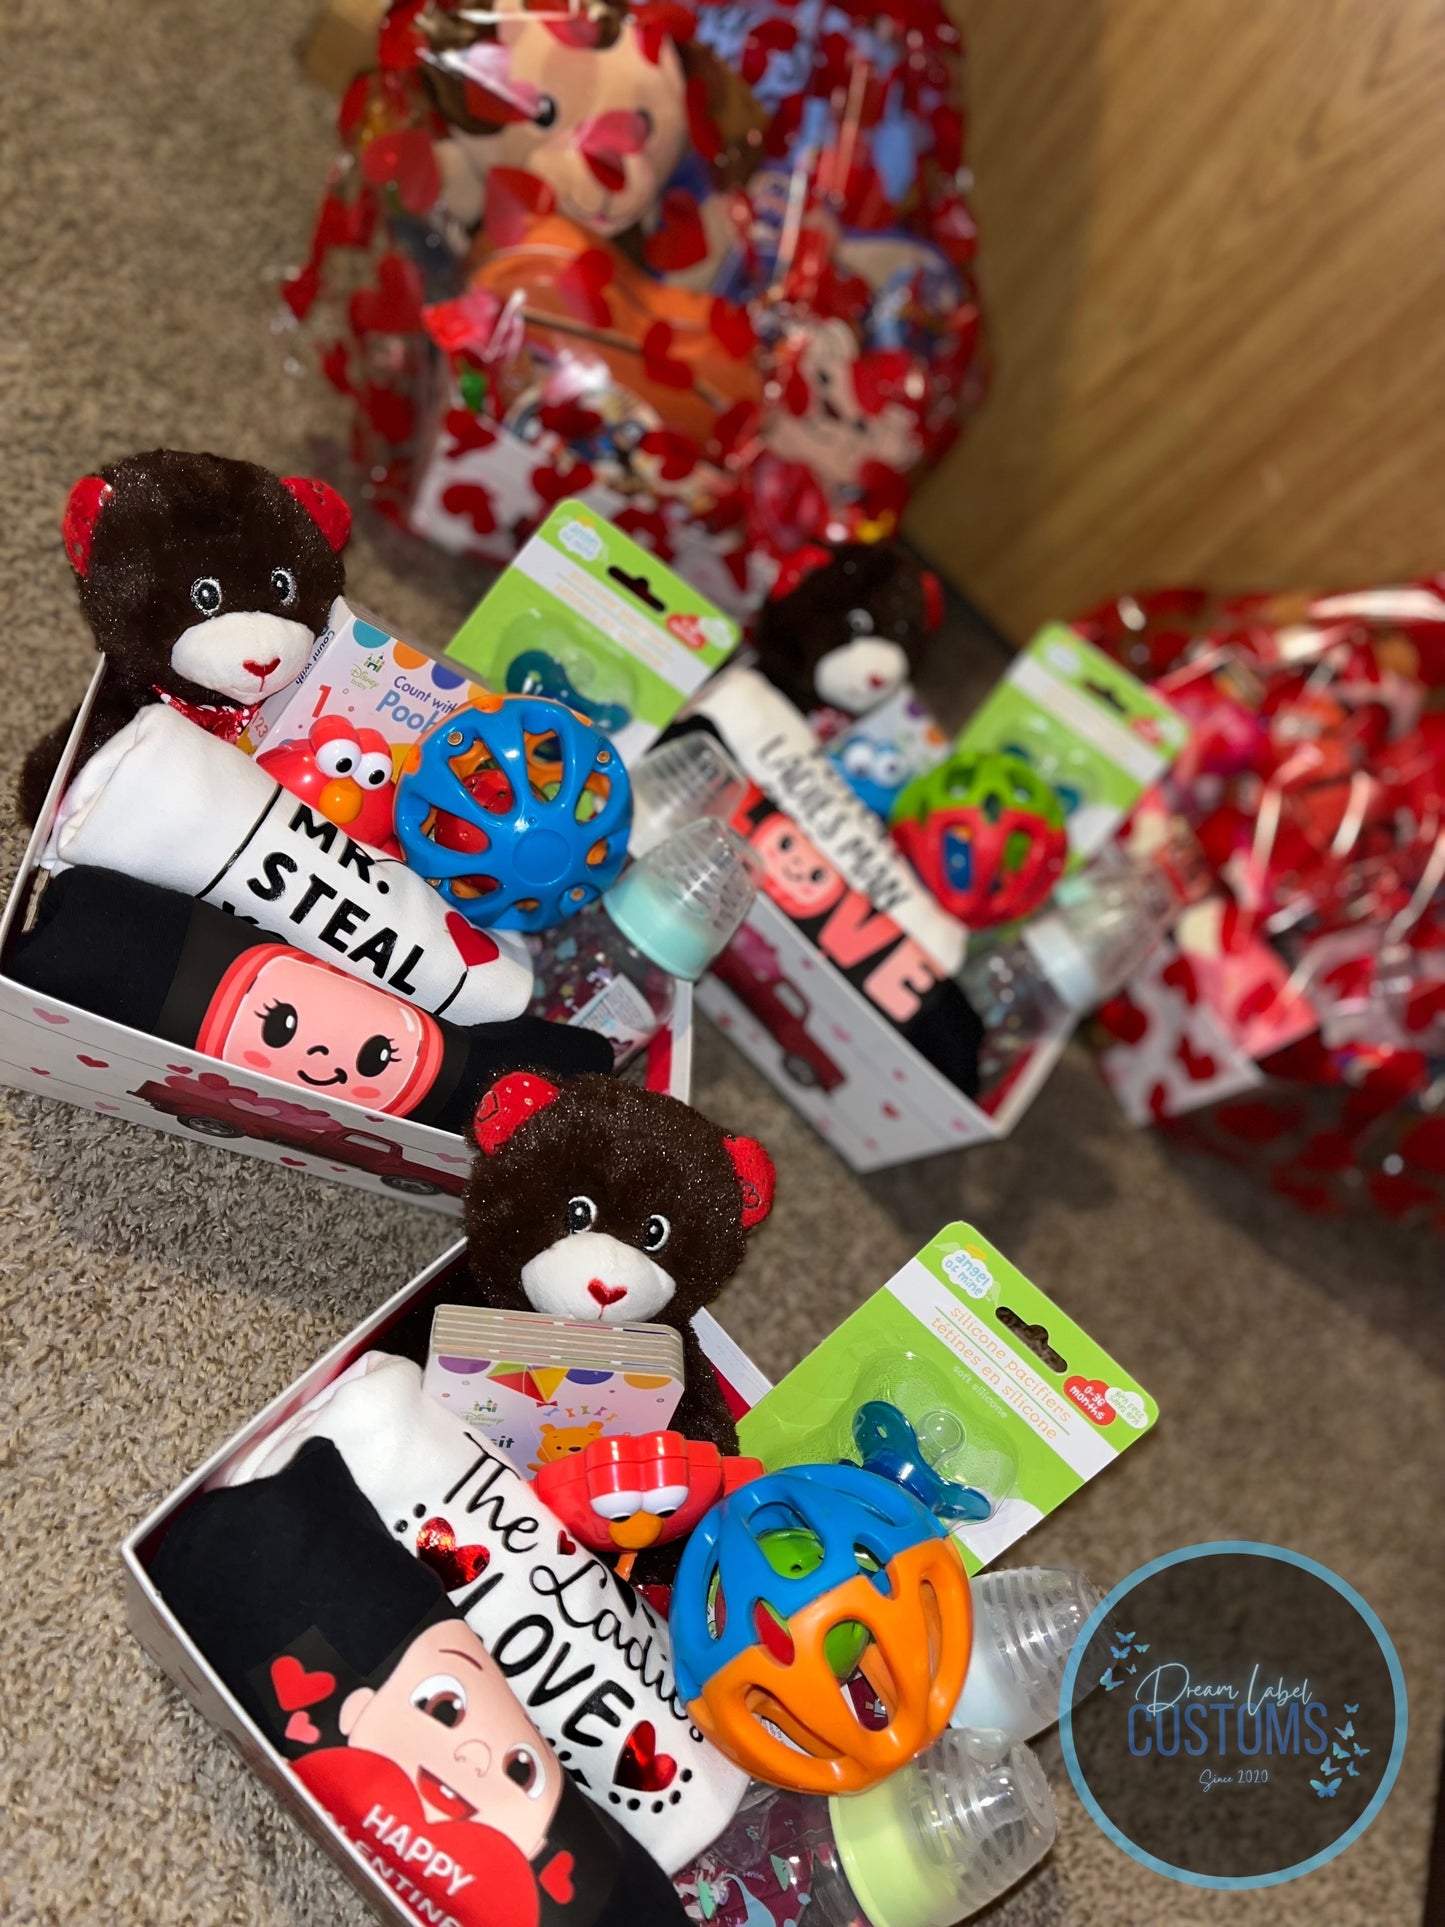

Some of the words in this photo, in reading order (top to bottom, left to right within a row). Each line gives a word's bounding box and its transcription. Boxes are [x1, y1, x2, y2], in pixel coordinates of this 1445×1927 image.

[351, 664, 379, 689] Disney
[394, 676, 431, 702] Count
[312, 684, 332, 718] 1
[288, 803, 390, 895] MR.
[246, 851, 425, 996] STEAL
[955, 1254, 990, 1286] angel
[957, 1271, 983, 1296] mine
[931, 1316, 981, 1366] tétines
[981, 1365, 1001, 1386] en
[1001, 1384, 1057, 1440] silicone
[950, 1306, 1006, 1360] silicone
[1004, 1359, 1071, 1423] pacifiers
[1069, 1385, 1105, 1420] months
[1084, 1386, 1106, 1407] 0-36
[443, 1431, 540, 1554] The
[362, 1804, 476, 1896] HAPPY
